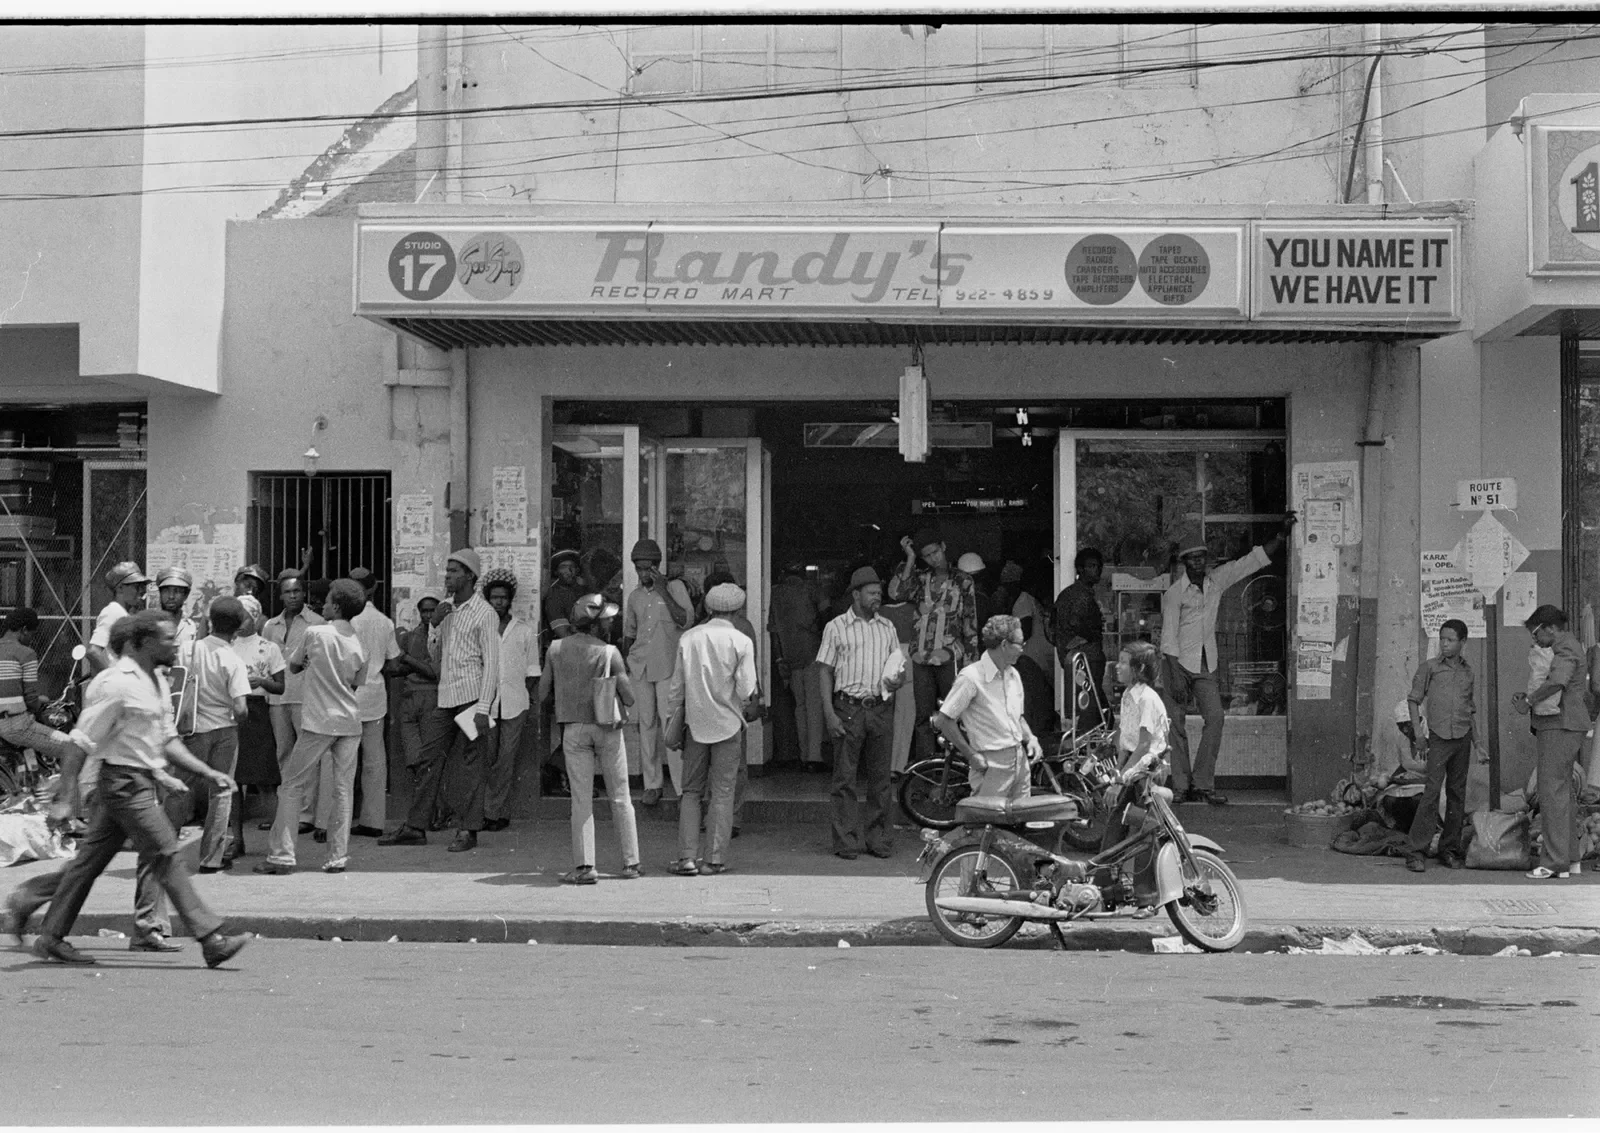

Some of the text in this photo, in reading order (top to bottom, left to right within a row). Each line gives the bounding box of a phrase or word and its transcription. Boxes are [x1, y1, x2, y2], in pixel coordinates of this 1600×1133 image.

[404, 241, 441, 249] STUDIO
[1082, 246, 1117, 254] RECORDS
[1266, 238, 1448, 268] YOU NAME IT
[1086, 255, 1113, 264] RADIOS
[1151, 255, 1198, 264] TAPE DECKS
[399, 254, 447, 291] 17
[594, 232, 972, 303] Randy's
[1072, 275, 1134, 284] TAPE RECORDERS
[591, 286, 698, 299] RECORD
[722, 287, 794, 300] MART
[1148, 285, 1192, 293] APPLIANCES
[1270, 275, 1437, 304] WE HAVE IT
[1469, 482, 1502, 492] ROUTE
[1486, 494, 1499, 505] 51
